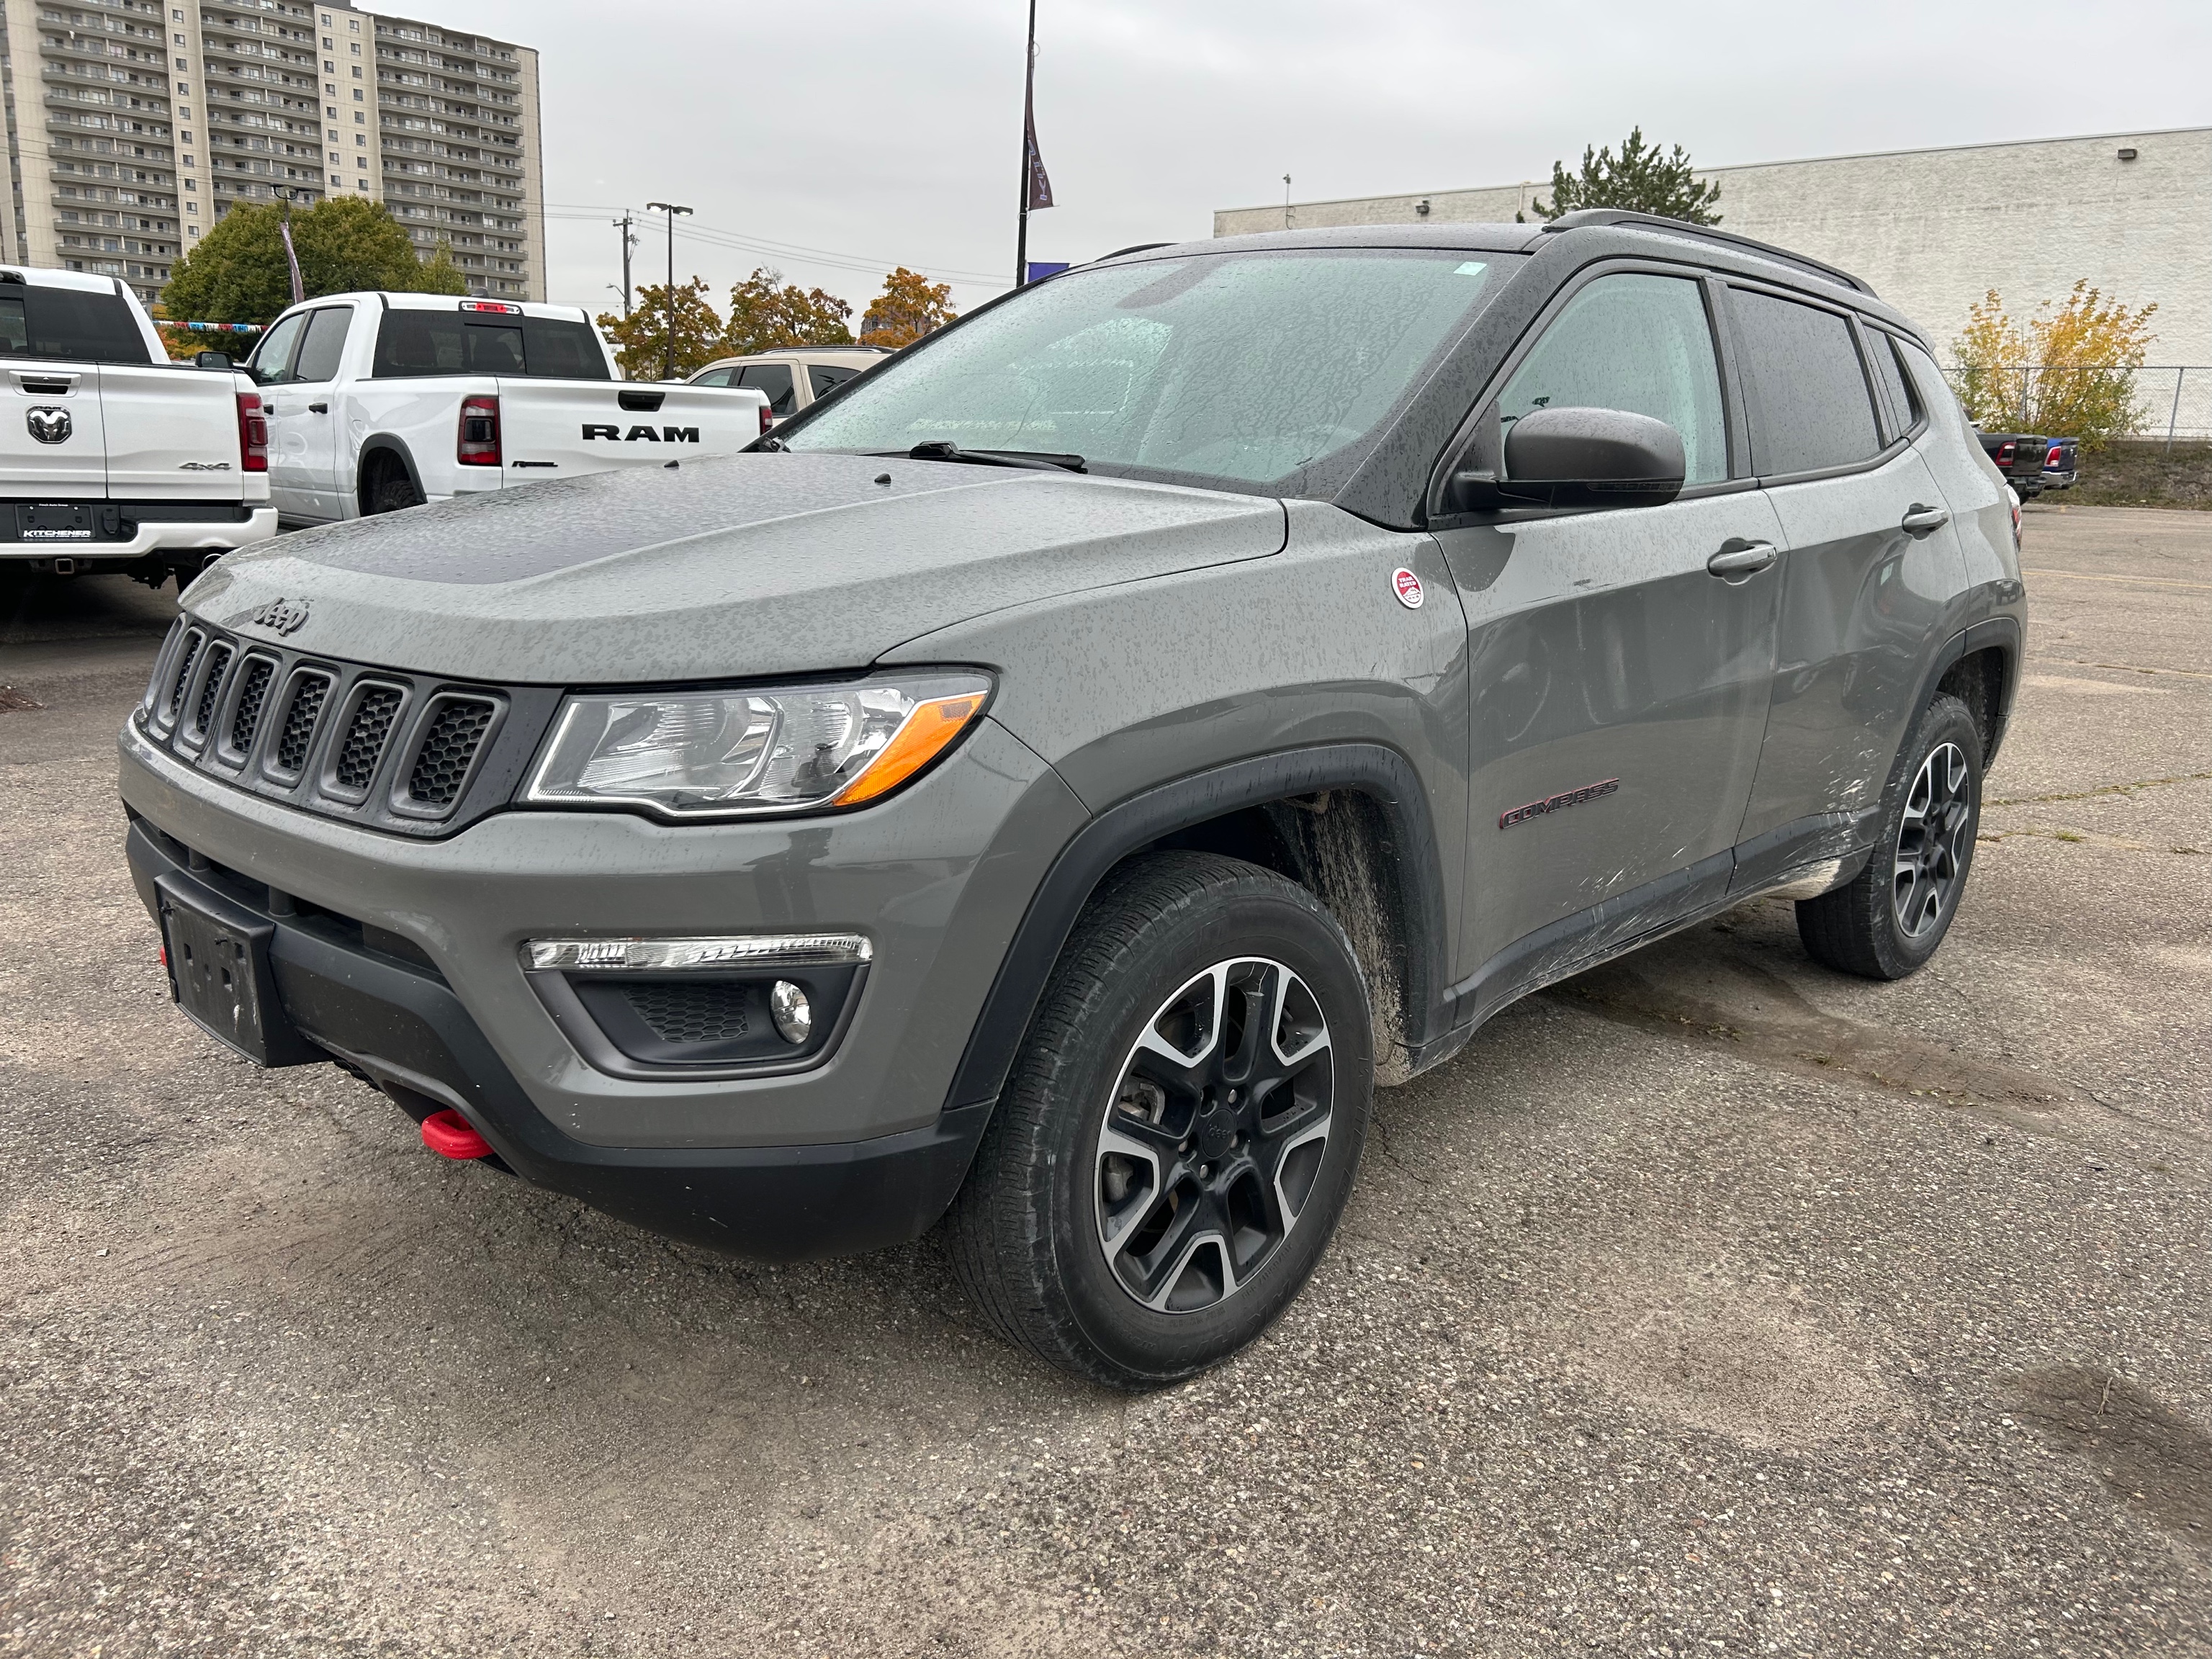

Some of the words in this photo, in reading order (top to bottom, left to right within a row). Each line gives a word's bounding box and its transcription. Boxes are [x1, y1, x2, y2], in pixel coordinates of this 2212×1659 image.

[582, 423, 699, 443] RAM
[253, 596, 310, 637] Jeep
[1500, 778, 1619, 829] COMPASS
